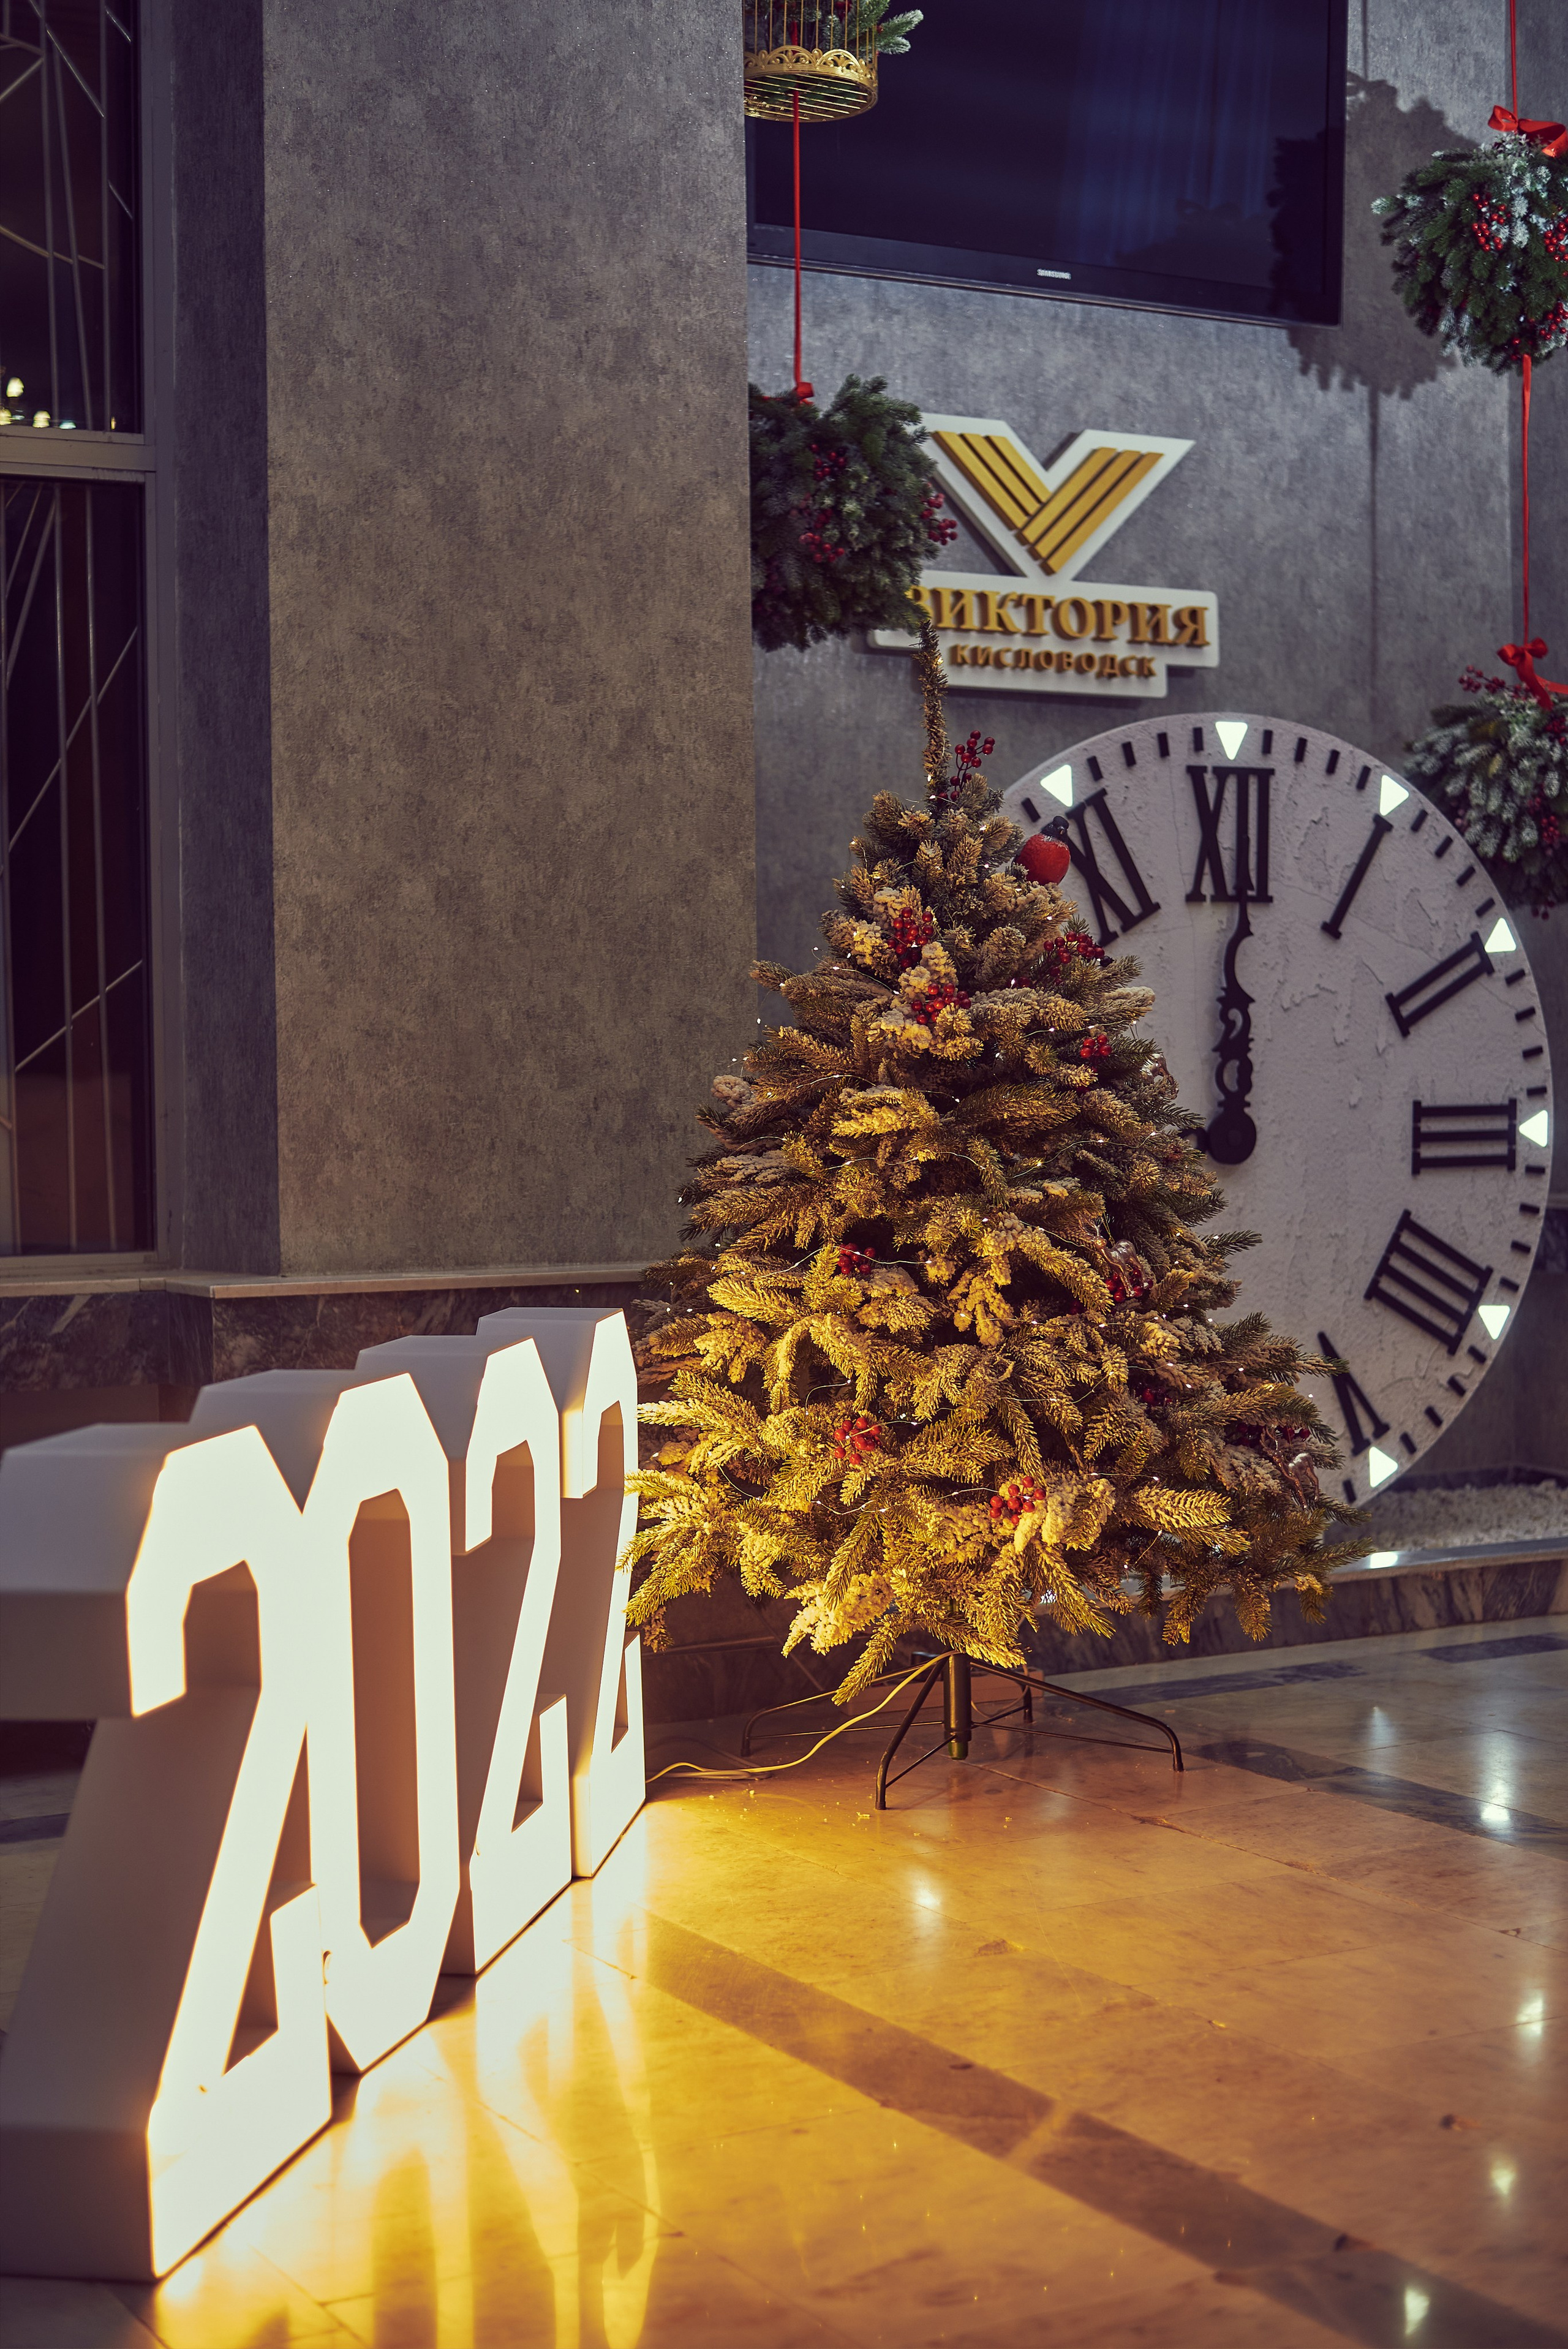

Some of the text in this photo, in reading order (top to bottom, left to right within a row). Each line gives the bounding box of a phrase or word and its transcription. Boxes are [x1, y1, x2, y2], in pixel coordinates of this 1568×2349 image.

[1036, 268, 1072, 280] SAMSUNG
[1412, 1098, 1518, 1175] III
[126, 1307, 647, 2279] 2022
